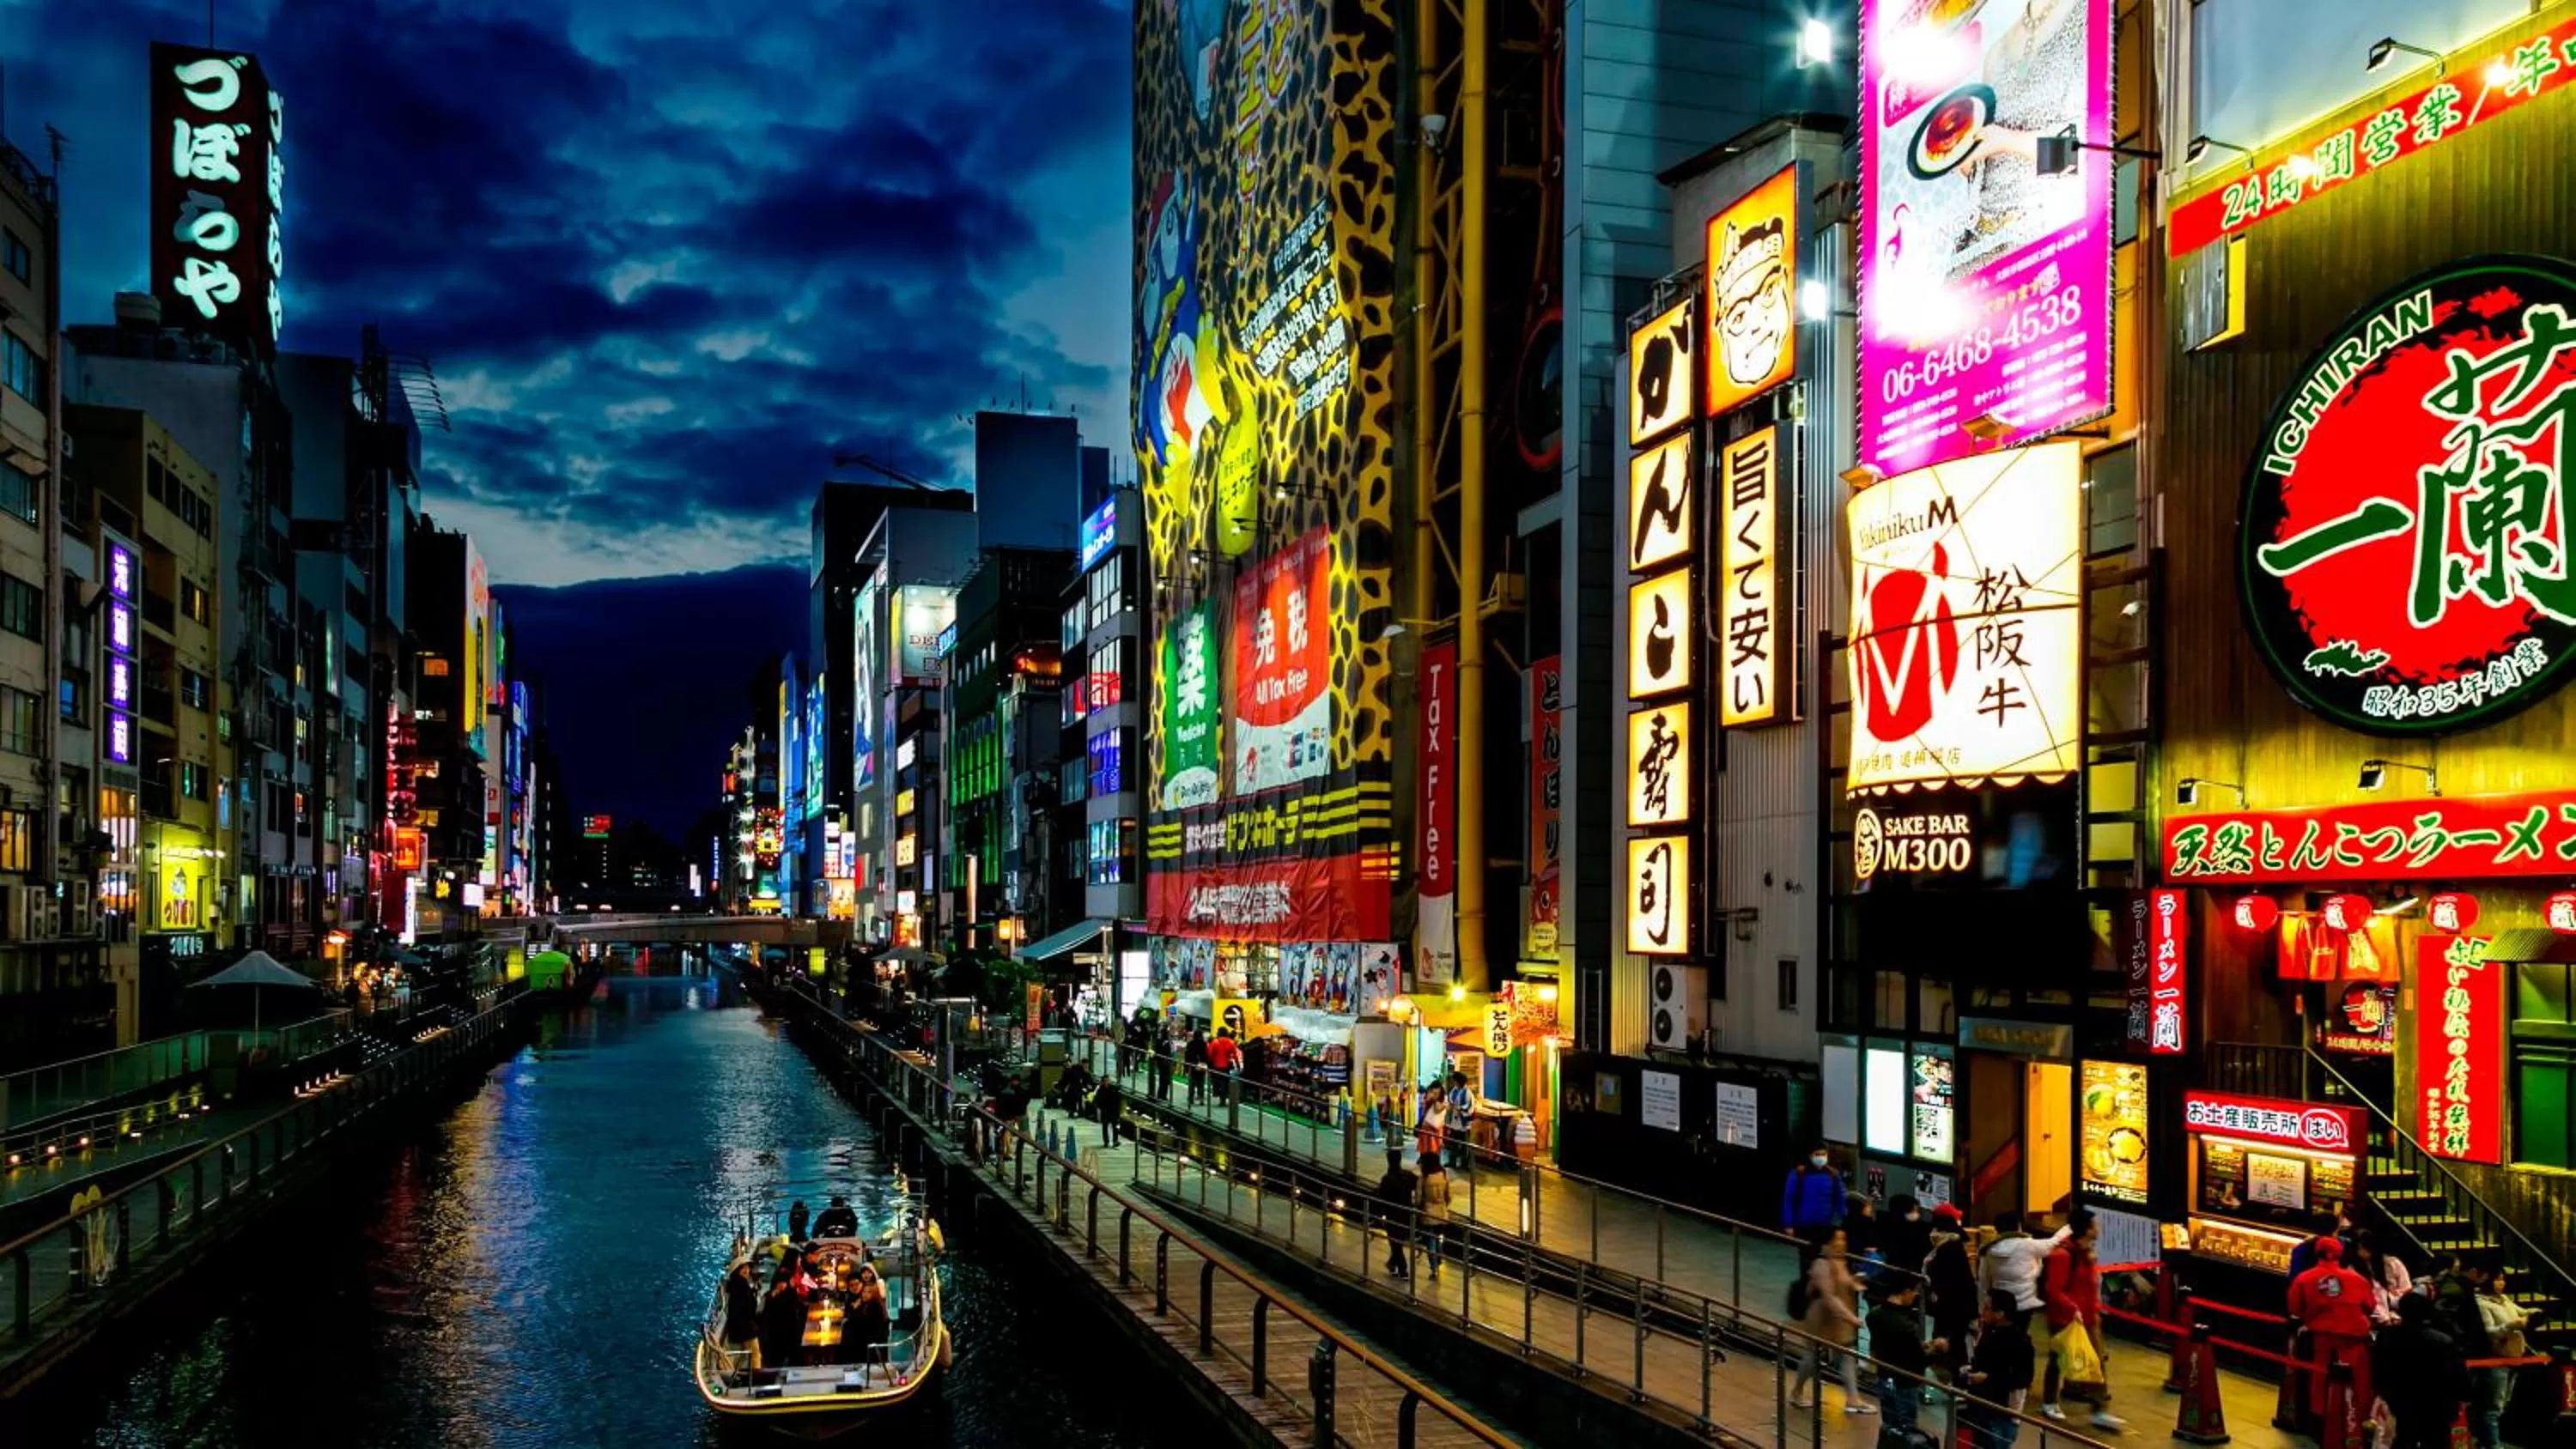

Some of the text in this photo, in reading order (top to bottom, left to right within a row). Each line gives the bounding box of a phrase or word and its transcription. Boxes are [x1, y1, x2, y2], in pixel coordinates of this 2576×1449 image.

[173, 55, 252, 319] づぼらや
[1882, 285, 2082, 403] 06-6468-4538
[2263, 289, 2435, 477] ICHIRAN
[1927, 495, 1959, 529] M
[1729, 441, 1771, 713] 旨くて安い
[1287, 667, 1308, 693] Free
[1974, 564, 2032, 728] 松阪牛
[2362, 638, 2549, 719] 昭和35年創業
[1425, 664, 1441, 882] Tax Free
[1884, 837, 1971, 871] M300
[1885, 815, 1970, 836] SAKE BAR
[2188, 1100, 2341, 1140] お土産販売所 はい
